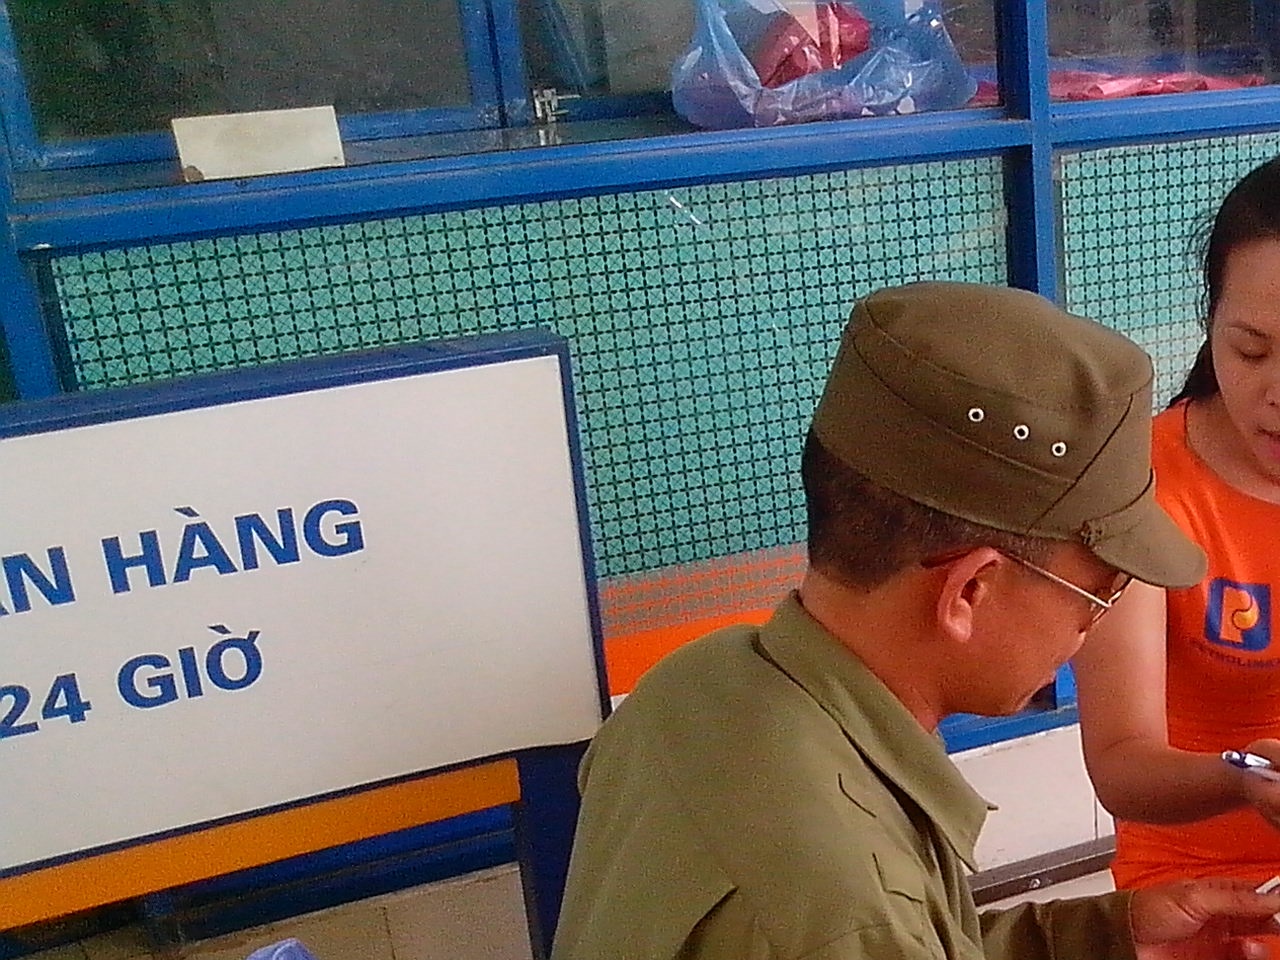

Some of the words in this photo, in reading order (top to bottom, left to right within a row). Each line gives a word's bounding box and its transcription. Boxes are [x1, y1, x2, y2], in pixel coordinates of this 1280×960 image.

[0, 546, 76, 617] N
[101, 499, 365, 595] HÀNG
[0, 673, 91, 740] 24
[117, 624, 262, 709] GIỜ
